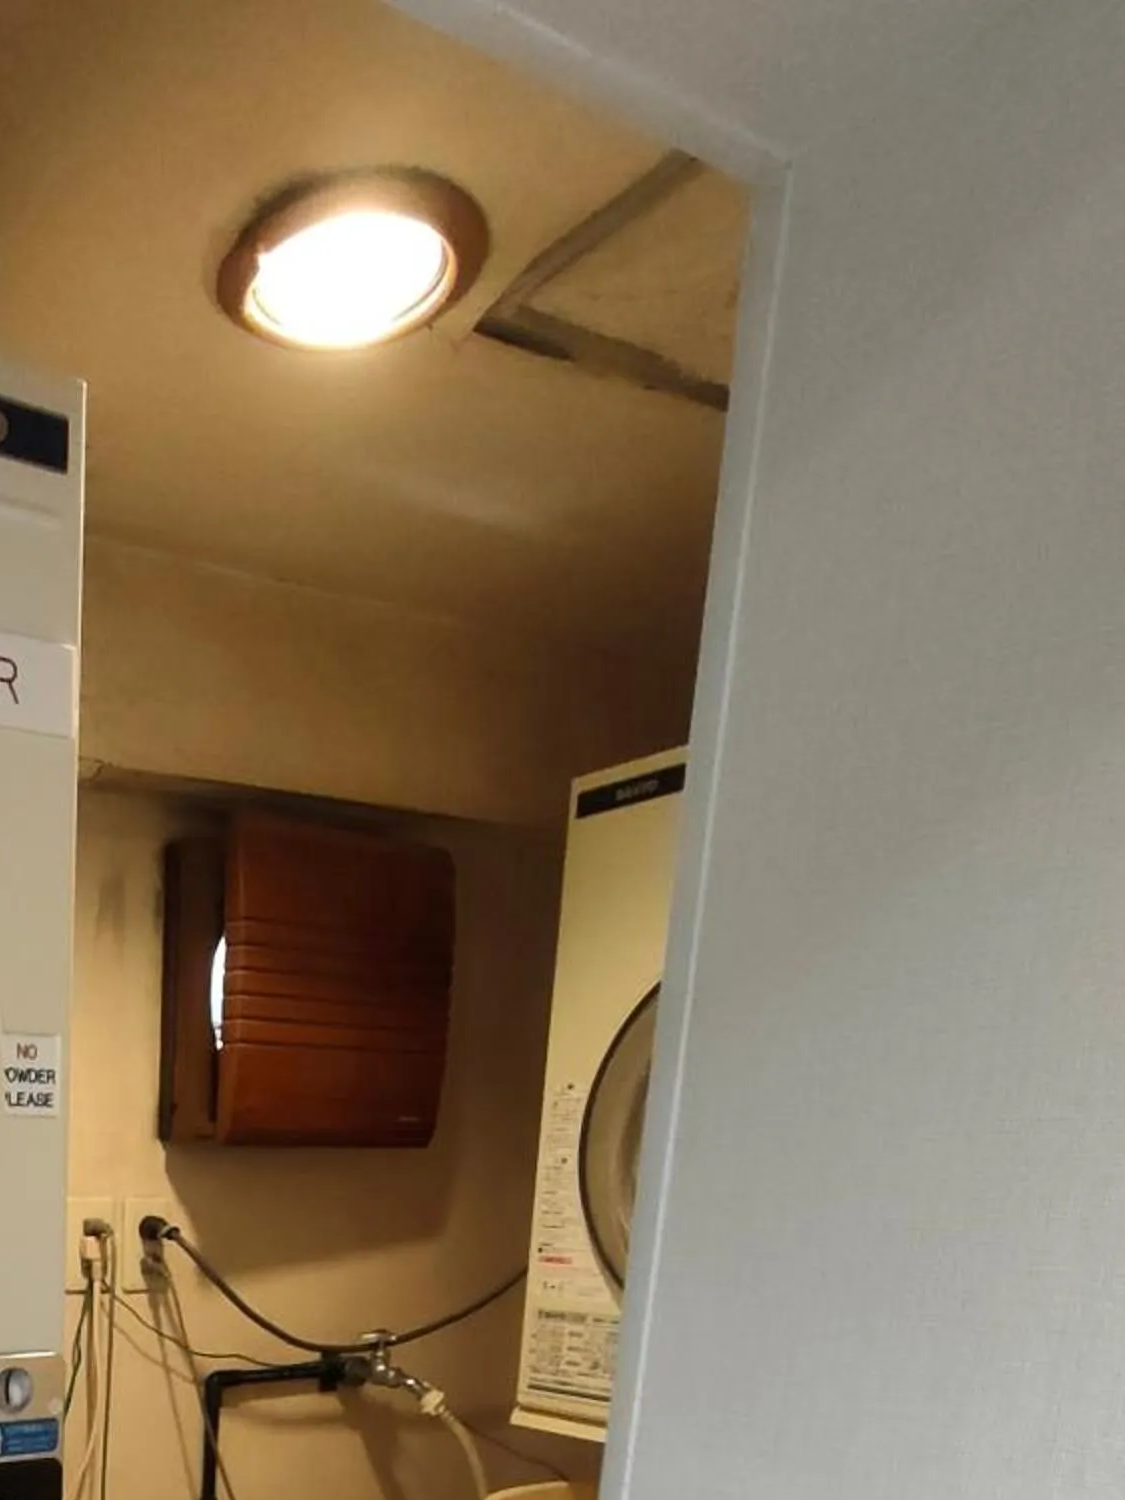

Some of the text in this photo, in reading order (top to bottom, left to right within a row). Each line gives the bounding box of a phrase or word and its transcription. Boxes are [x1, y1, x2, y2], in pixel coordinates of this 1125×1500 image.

[16, 1042, 38, 1060] NO
[4, 1066, 56, 1085] OWDER
[5, 1091, 54, 1108] LEASE
